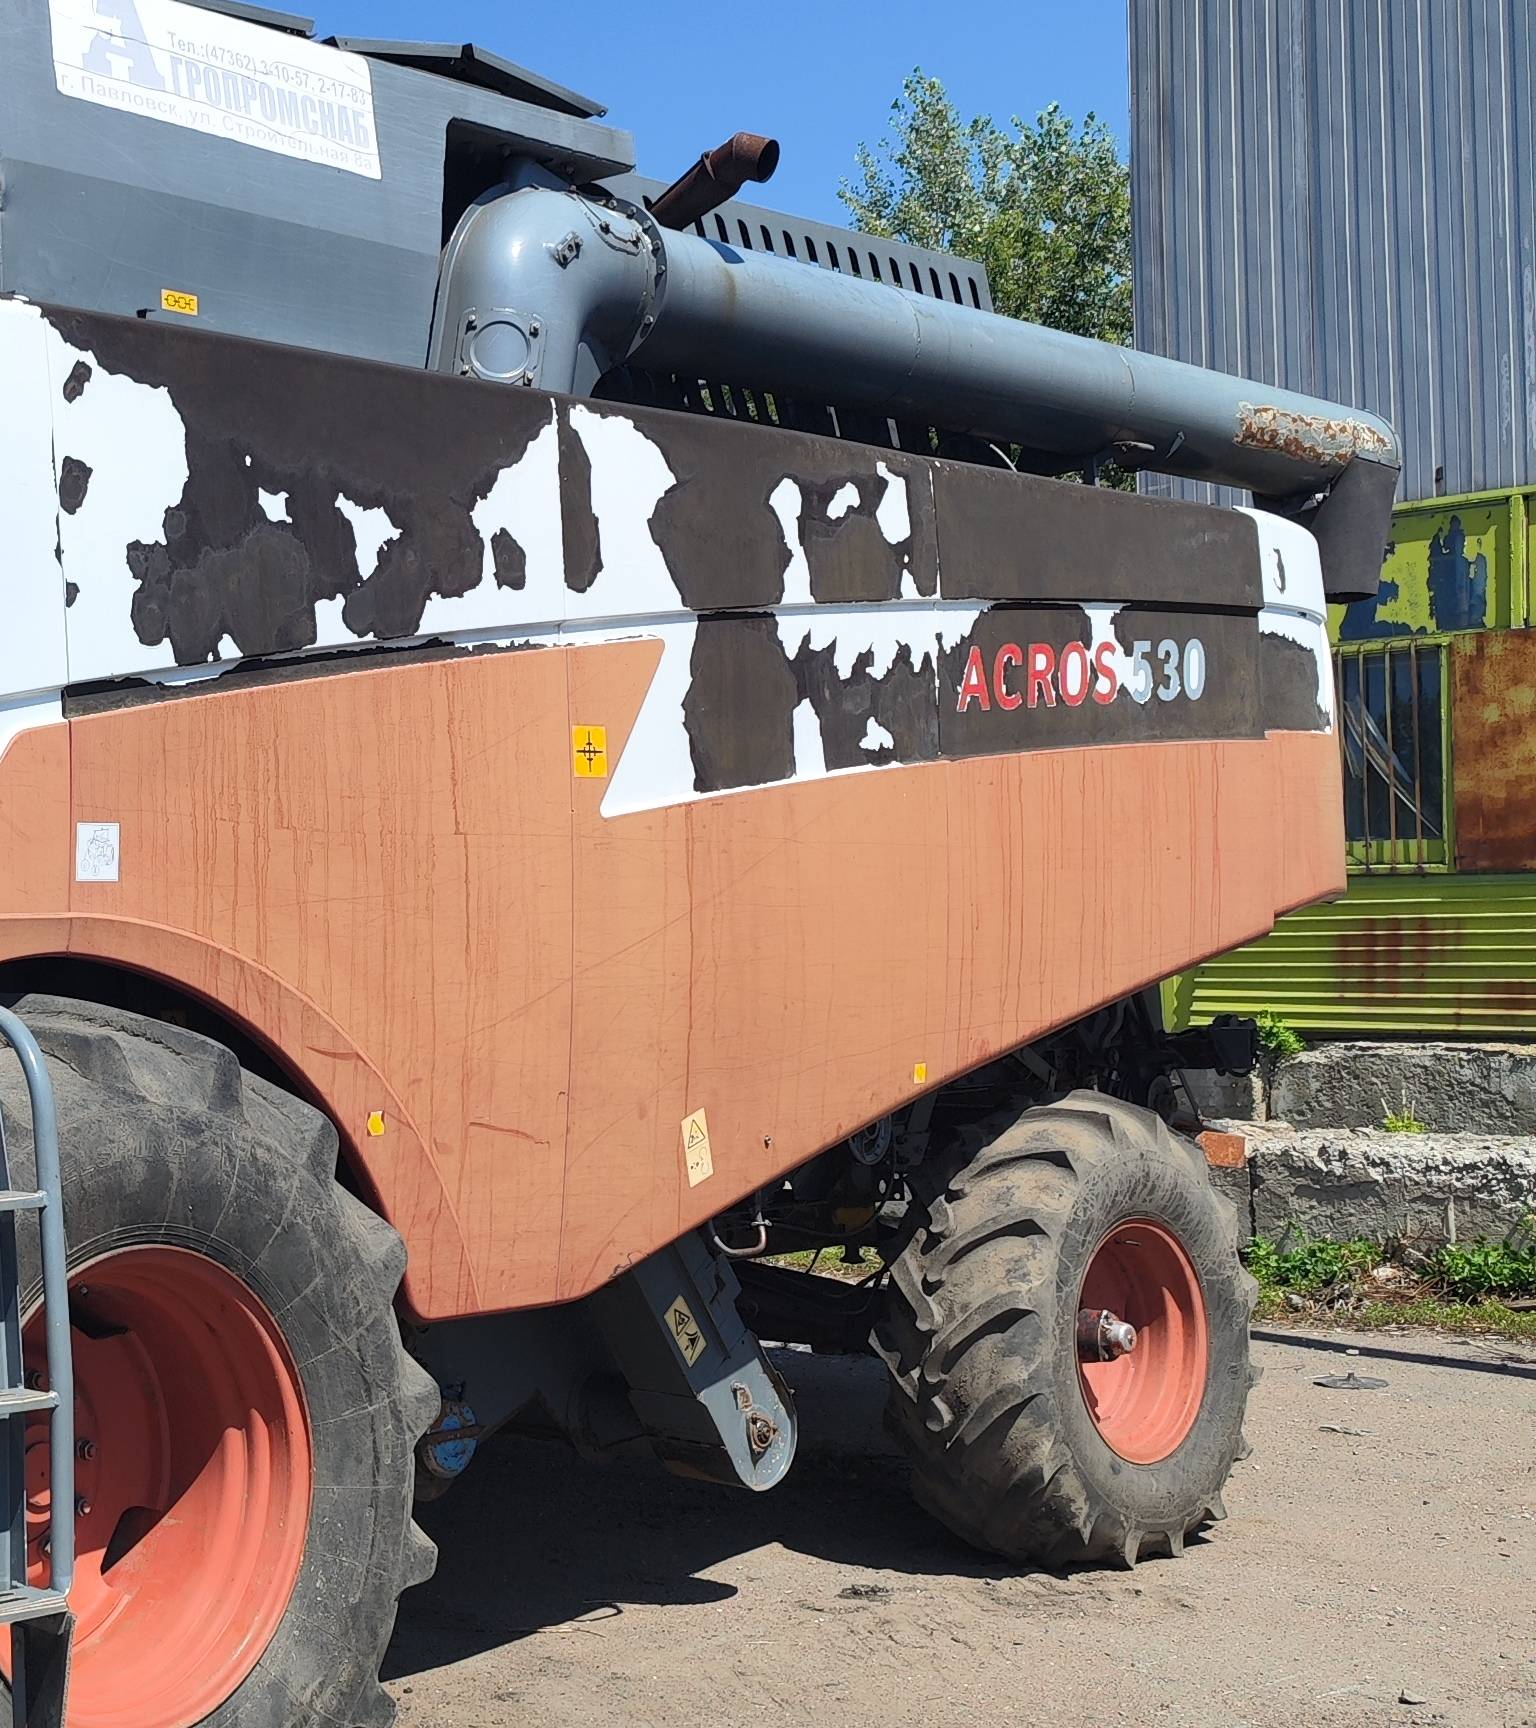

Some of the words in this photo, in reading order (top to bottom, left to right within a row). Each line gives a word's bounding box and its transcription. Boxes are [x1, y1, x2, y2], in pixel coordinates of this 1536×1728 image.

[61, 74, 74, 89] г.
[318, 77, 367, 105] 2-17-83
[956, 640, 1118, 713] ACROS
[1131, 637, 1207, 705] 530
